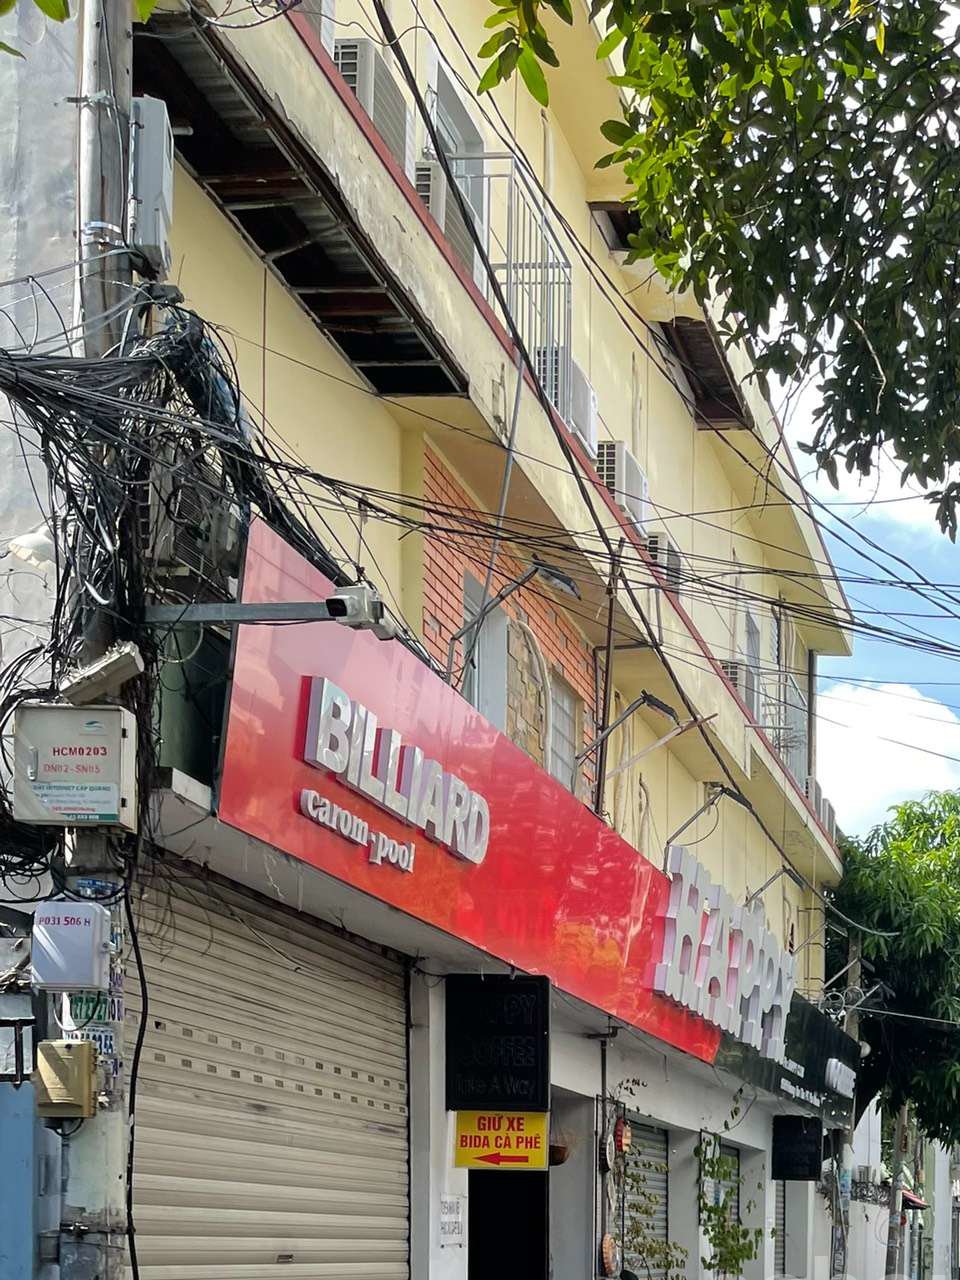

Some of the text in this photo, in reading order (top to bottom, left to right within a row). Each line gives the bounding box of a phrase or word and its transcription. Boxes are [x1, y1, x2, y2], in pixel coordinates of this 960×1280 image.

[52, 747, 108, 756] HCM0203
[304, 677, 490, 865] BILLIARD
[63, 916, 82, 926] 506
[653, 846, 795, 1066] HAPPY
[506, 1117, 524, 1131] XE
[460, 1133, 541, 1149] BIDA CÀ PHÊ
